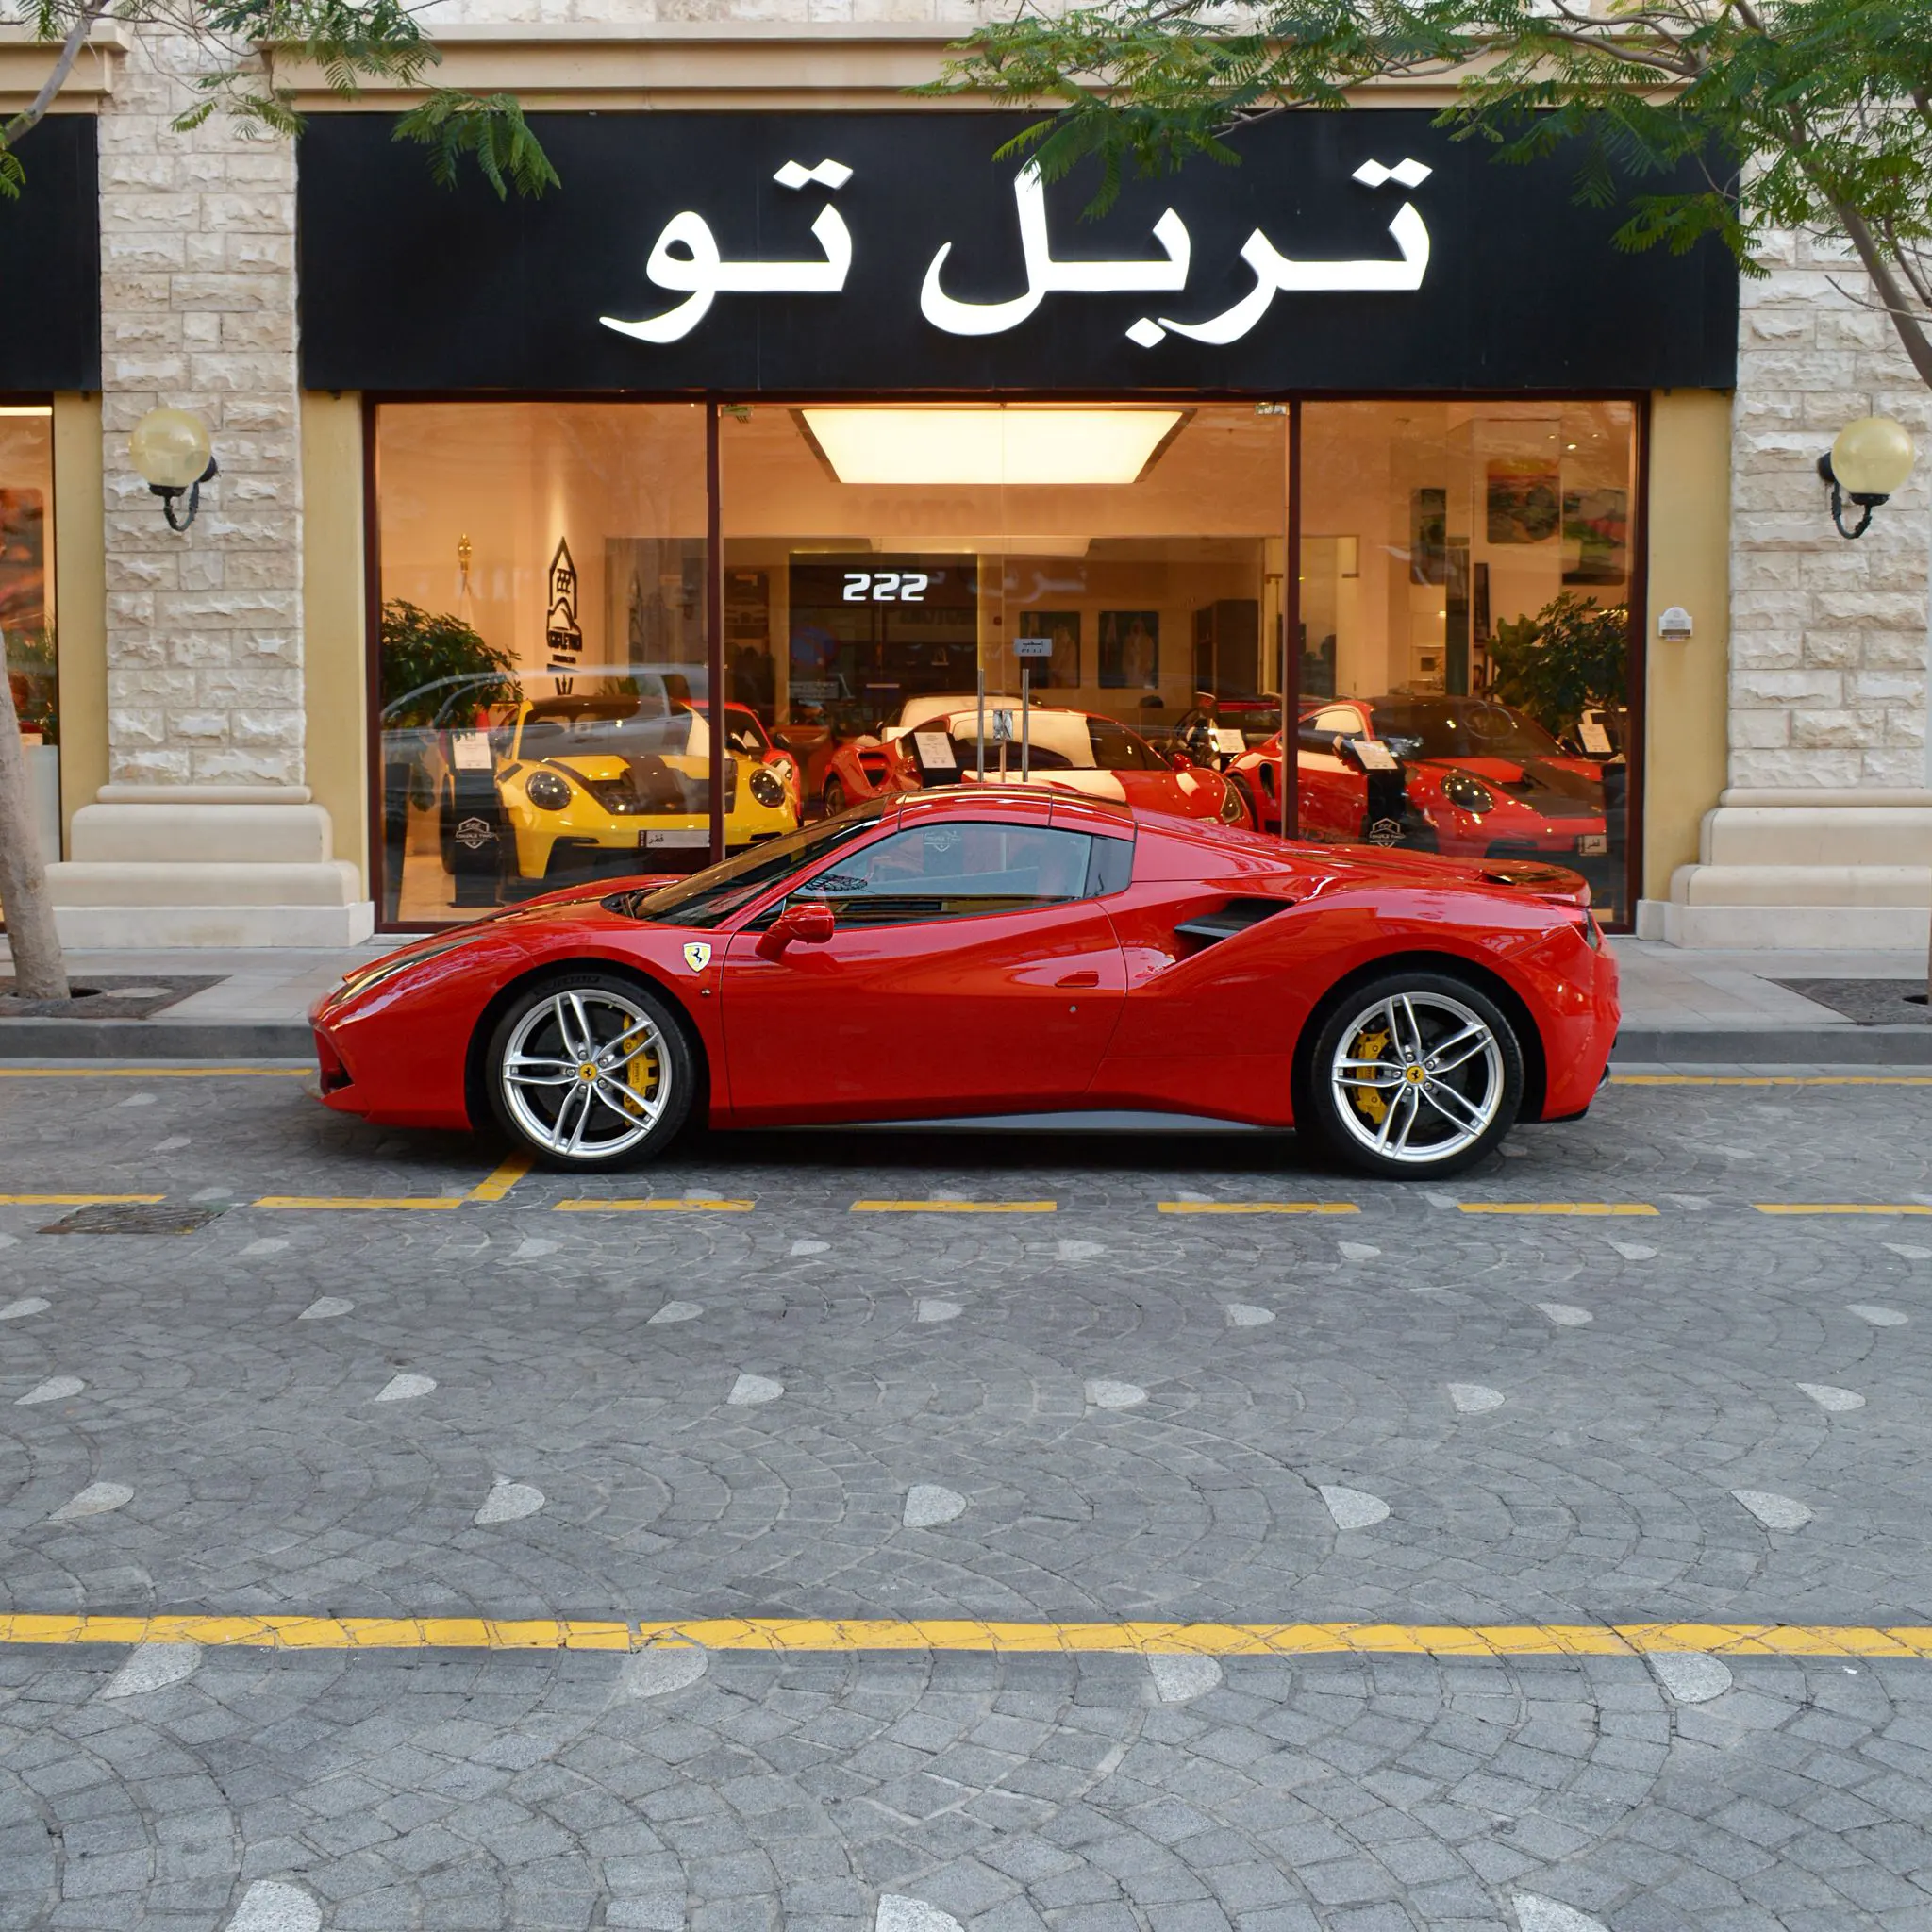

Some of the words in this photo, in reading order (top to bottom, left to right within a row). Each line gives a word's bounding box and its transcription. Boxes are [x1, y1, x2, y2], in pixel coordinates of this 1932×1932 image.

[598, 158, 854, 344] تو
[920, 155, 1433, 349] تربل
[842, 573, 928, 601] 222
